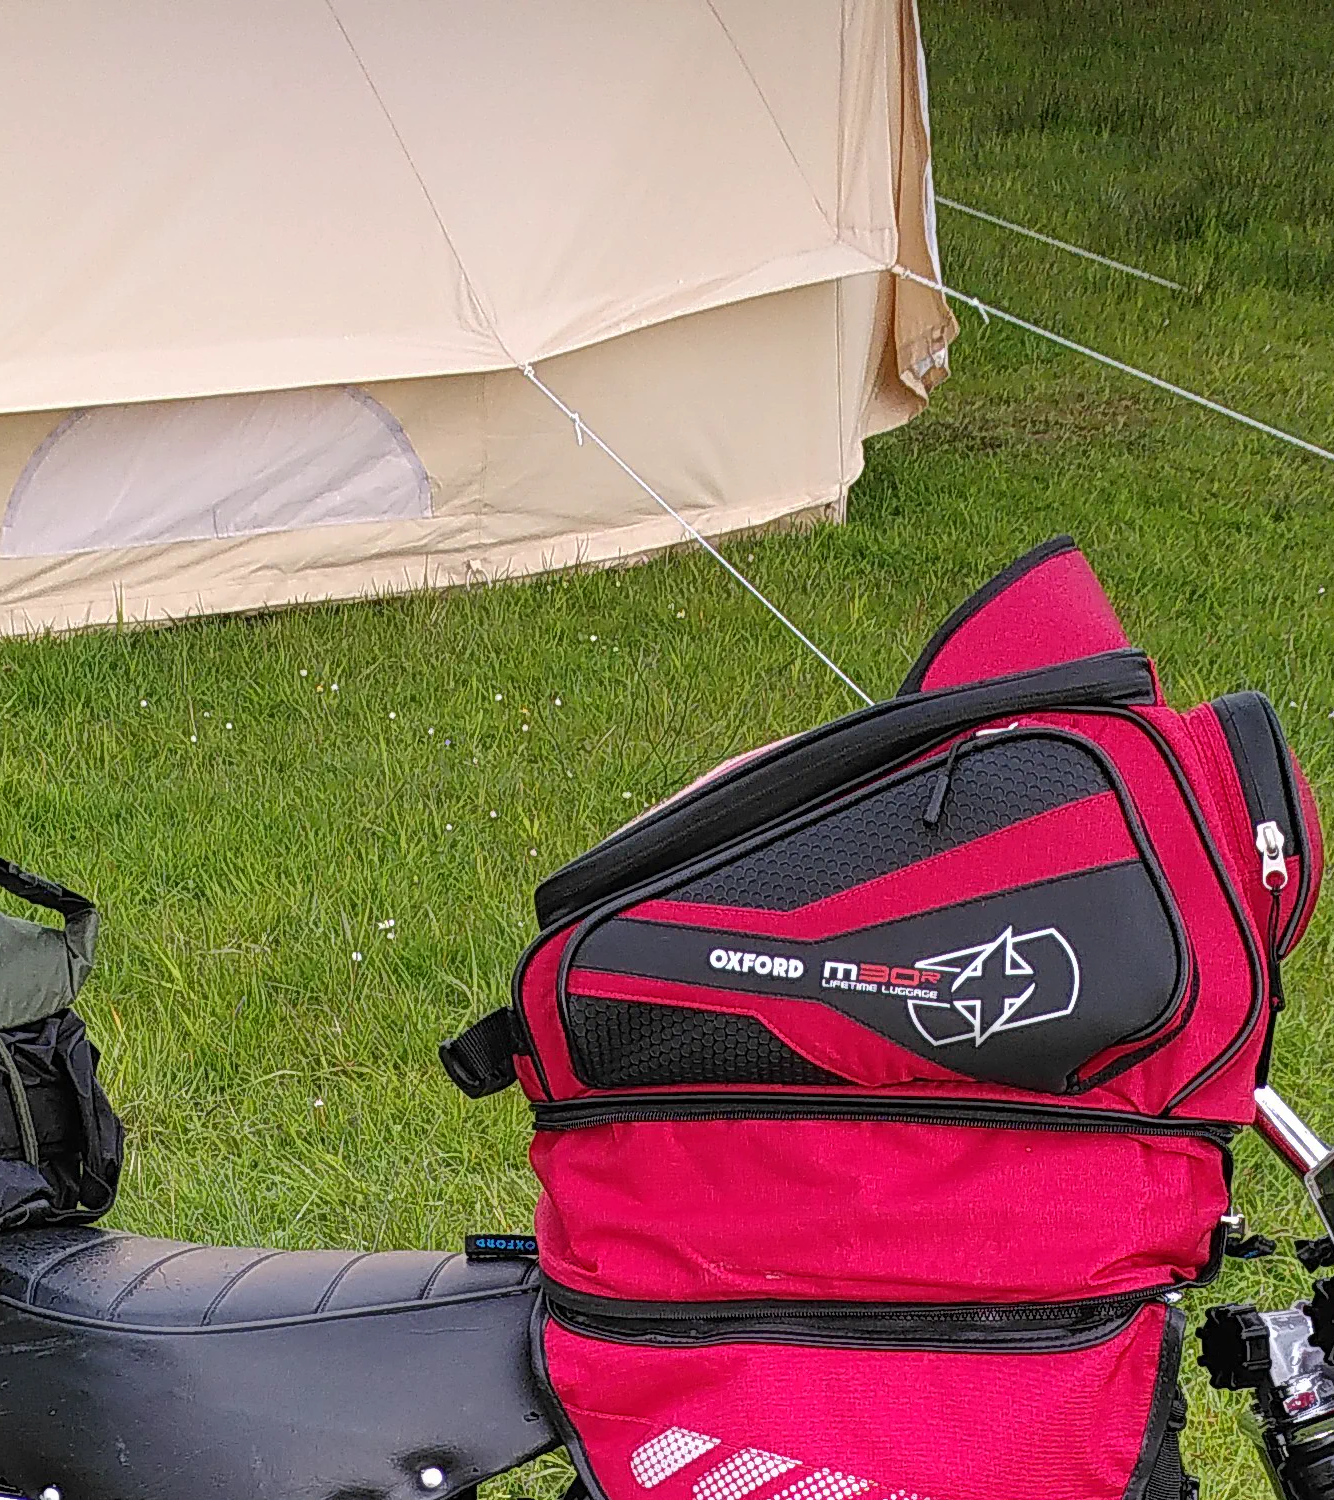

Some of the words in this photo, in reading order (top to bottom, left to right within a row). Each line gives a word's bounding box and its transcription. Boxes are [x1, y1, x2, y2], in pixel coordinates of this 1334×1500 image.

[709, 949, 804, 978] OXFORD
[822, 978, 877, 993] LIFETIME
[881, 984, 938, 999] LUGGAGE
[475, 1238, 535, 1251] OXFORD
